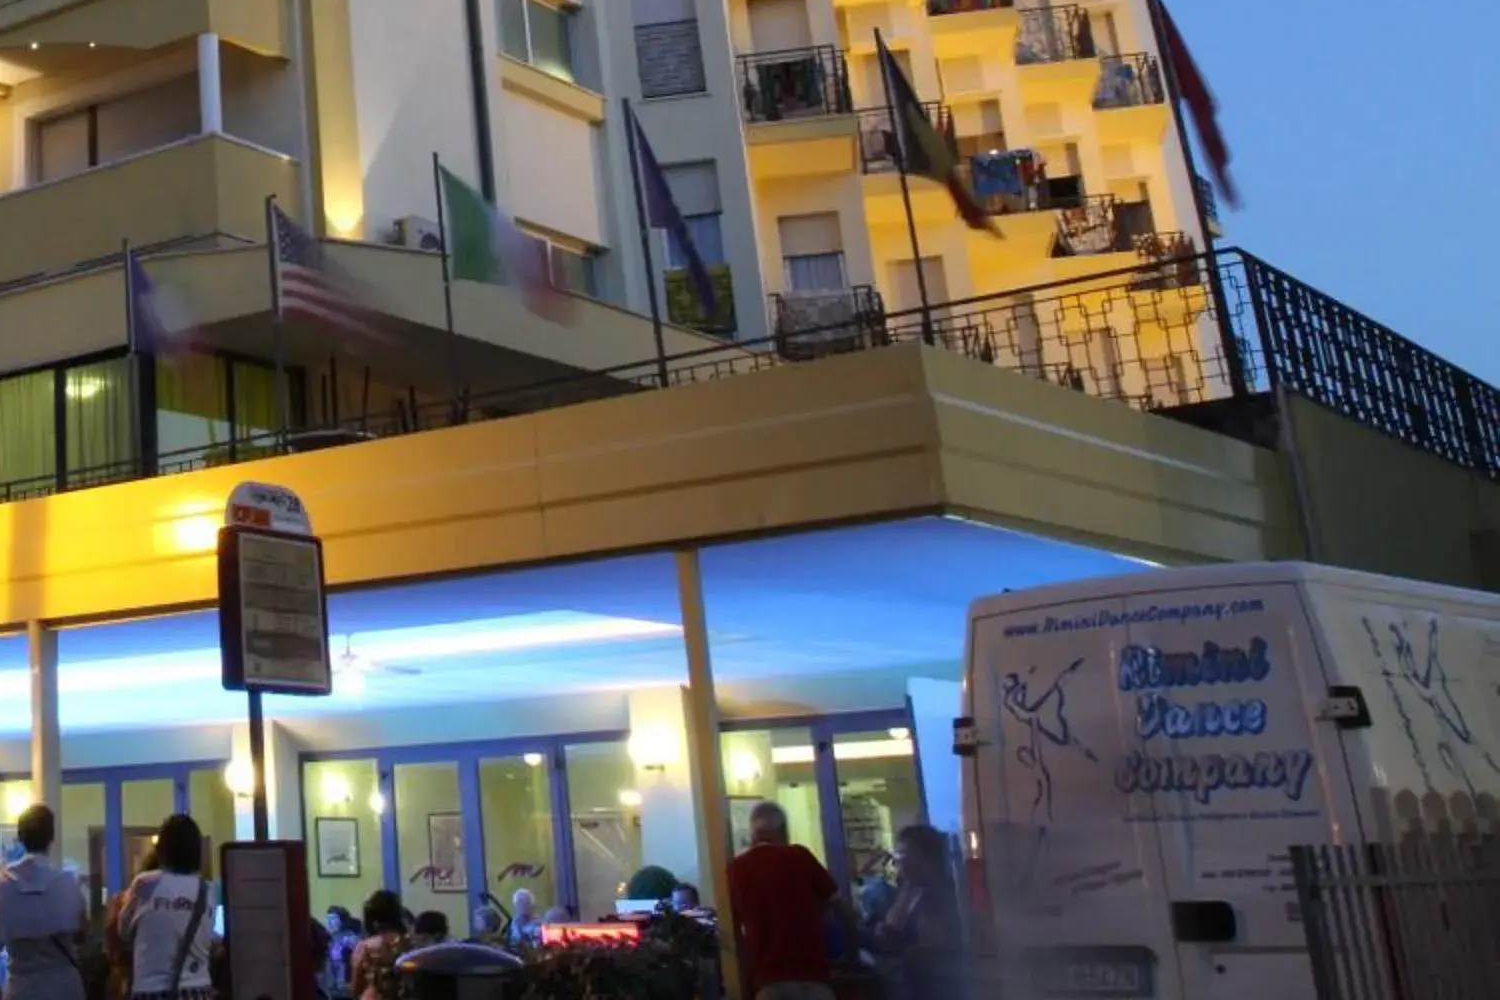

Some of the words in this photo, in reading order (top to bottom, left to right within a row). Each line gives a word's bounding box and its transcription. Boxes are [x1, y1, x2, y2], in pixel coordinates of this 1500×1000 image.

[1119, 635, 1271, 691] Rimini
[1136, 694, 1267, 740] Dance
[1114, 749, 1313, 805] Company
